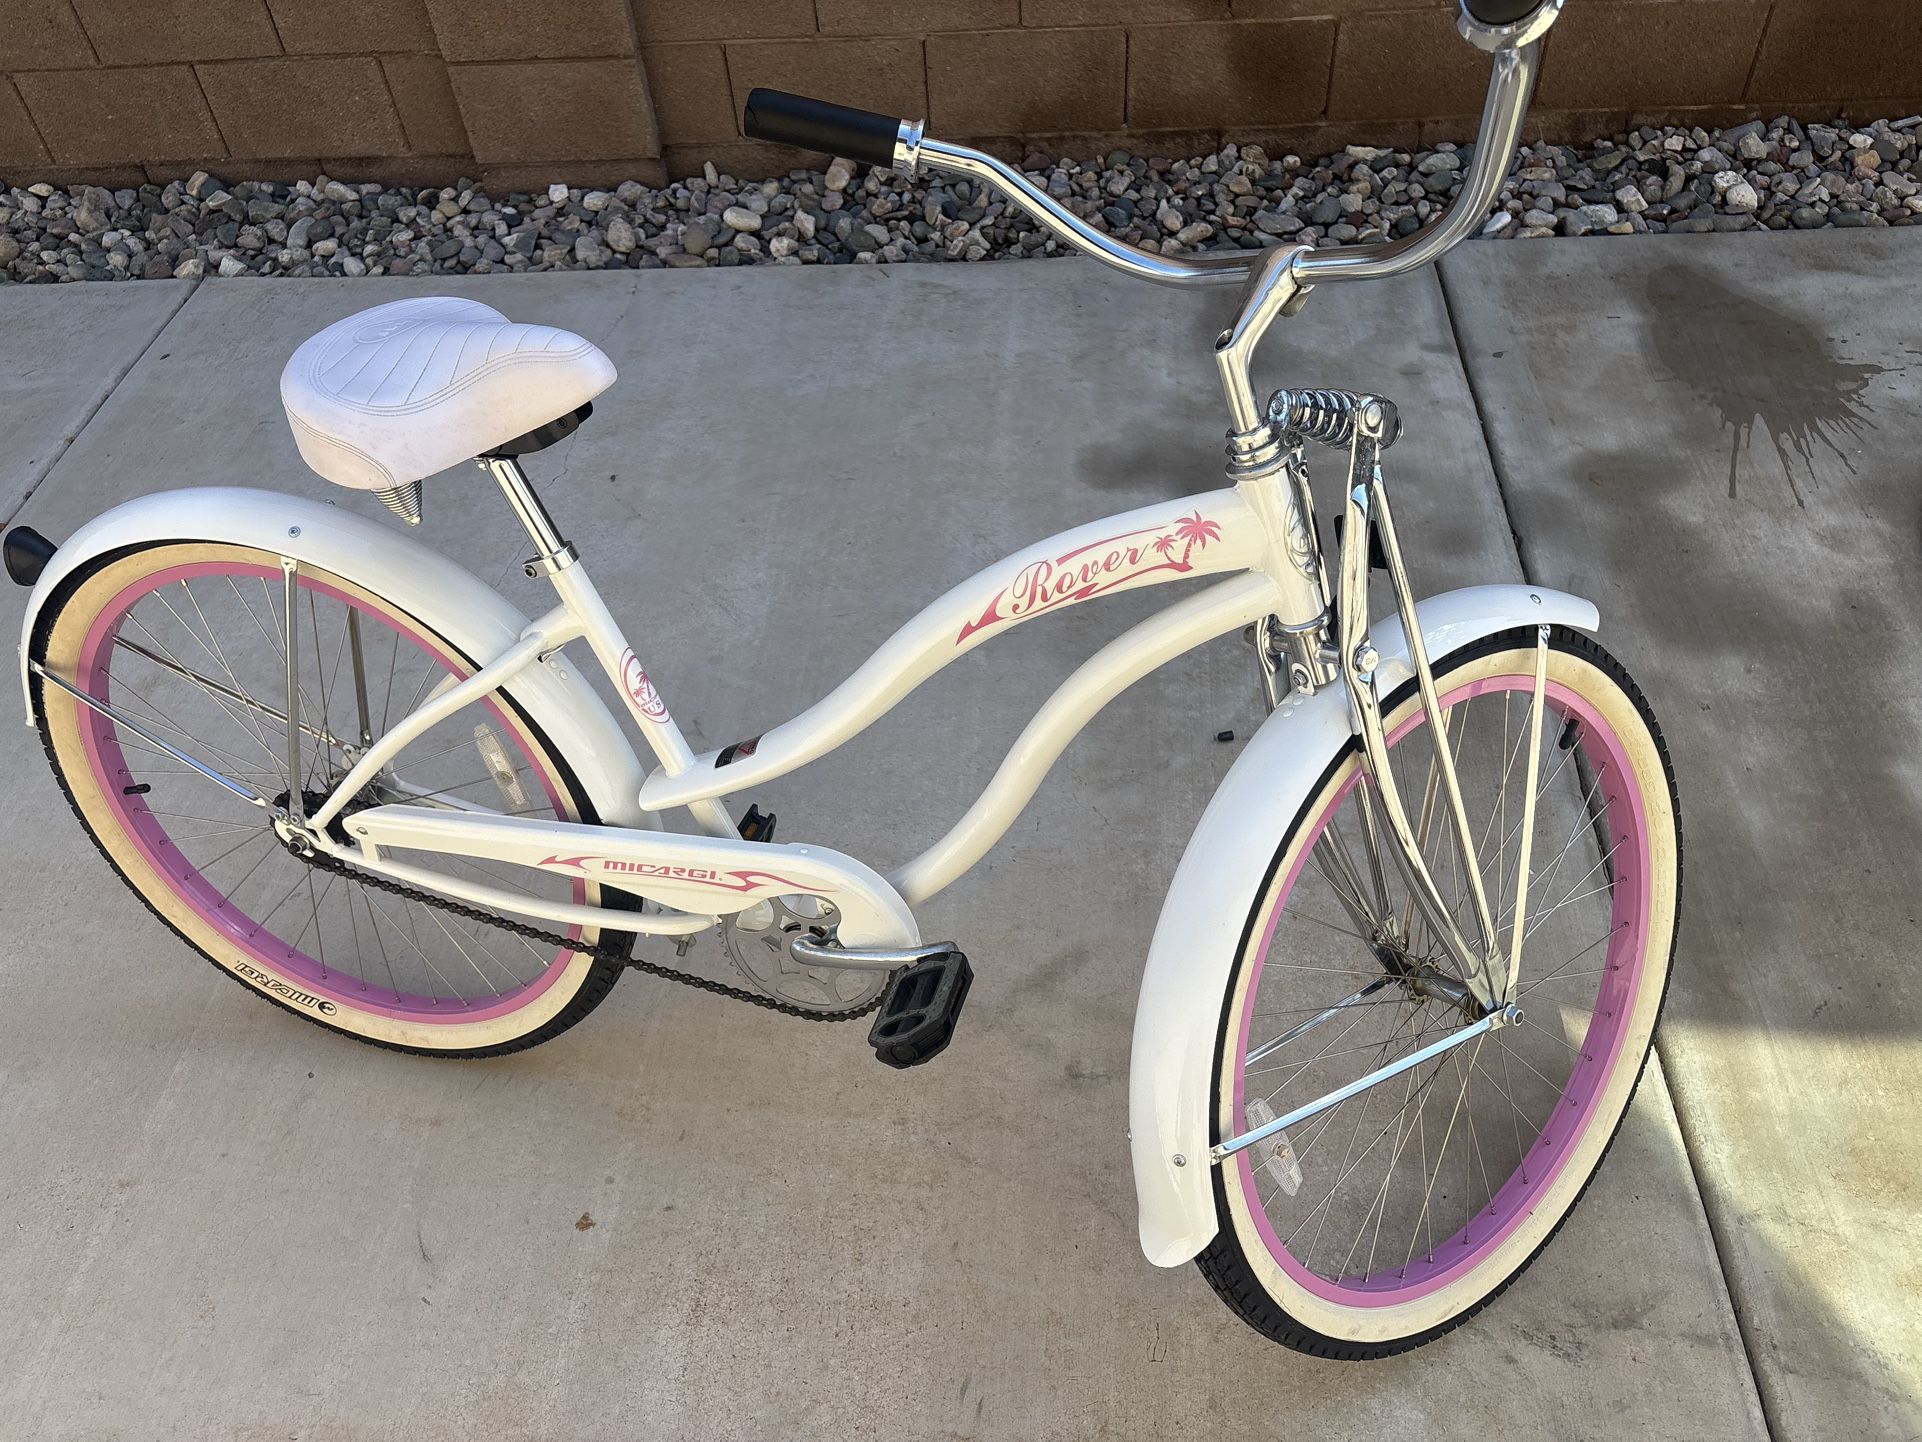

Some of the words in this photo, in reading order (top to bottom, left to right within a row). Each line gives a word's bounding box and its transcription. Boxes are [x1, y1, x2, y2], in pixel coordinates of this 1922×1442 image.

[1012, 543, 1149, 614] Rover
[604, 860, 716, 881] MICARGI
[234, 962, 320, 1008] MICARGI
